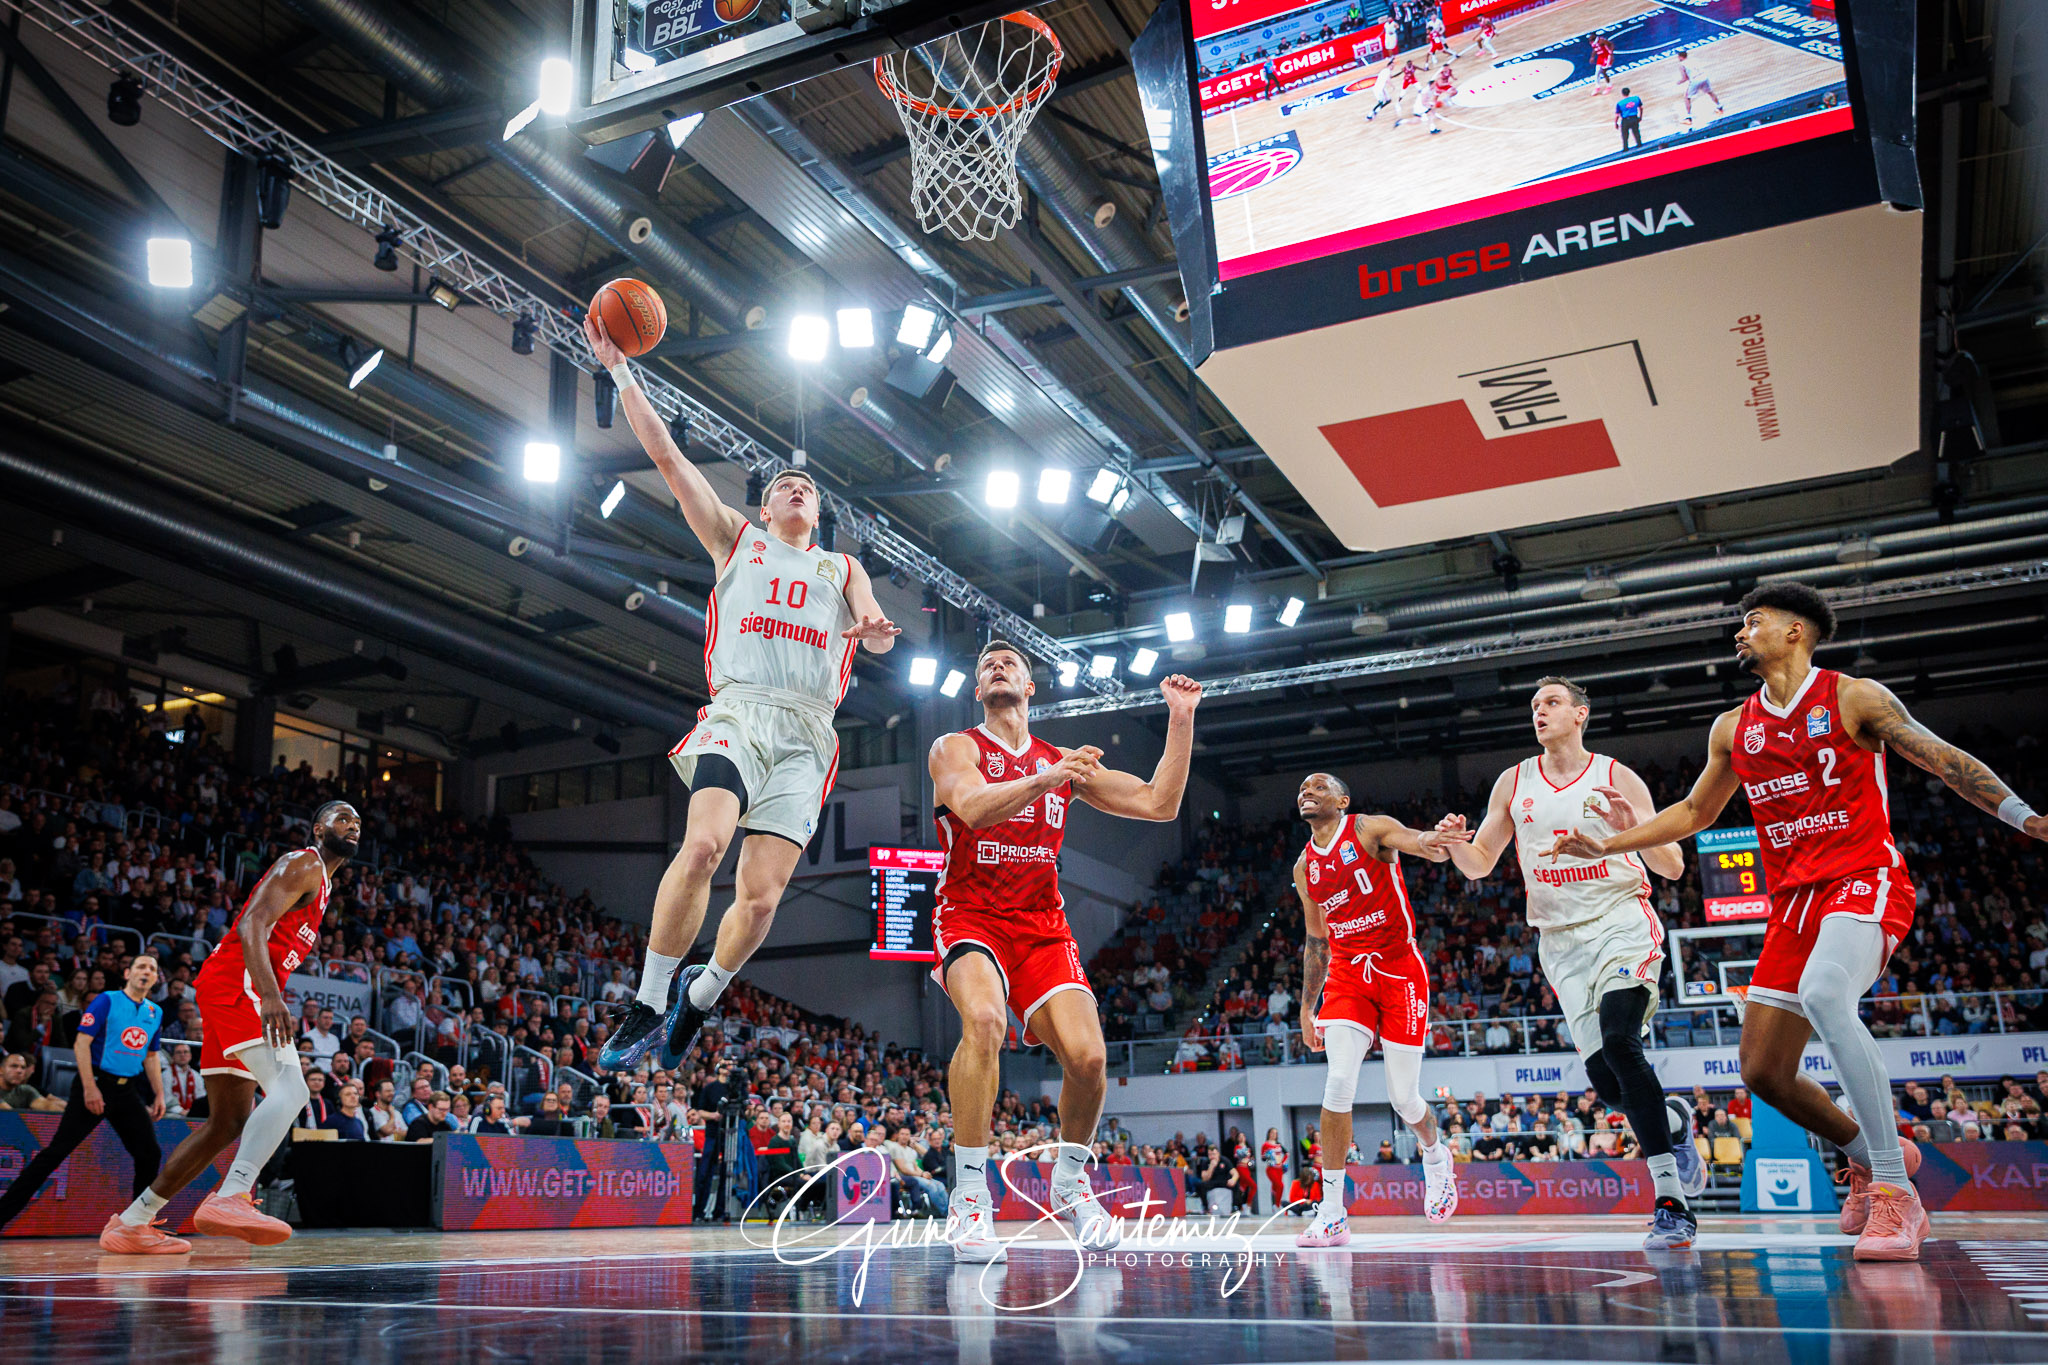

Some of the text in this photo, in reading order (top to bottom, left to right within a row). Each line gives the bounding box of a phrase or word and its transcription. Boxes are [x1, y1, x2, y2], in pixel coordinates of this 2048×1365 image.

[653, 13, 702, 46] BBL
[1358, 202, 1695, 300] brose ARENA
[1729, 313, 1780, 442] www.fim-online.de
[1478, 367, 1568, 431] FIM
[765, 577, 808, 609] 10
[740, 611, 828, 650] siegmund
[1817, 747, 1841, 787] 2
[1744, 772, 1808, 799] brose
[1045, 792, 1065, 829] 65
[877, 849, 890, 859] 59
[1000, 844, 1056, 859] PRIOSAFE
[1354, 868, 1373, 895] 0
[1740, 871, 1756, 893] 9
[1709, 901, 1765, 918] tipico
[299, 990, 363, 1012] ARENA
[1910, 1050, 1966, 1066] PFLAUM
[1516, 1067, 1561, 1083] PFLAUM
[462, 1167, 681, 1197] WWW.GET-IT.GMBH
